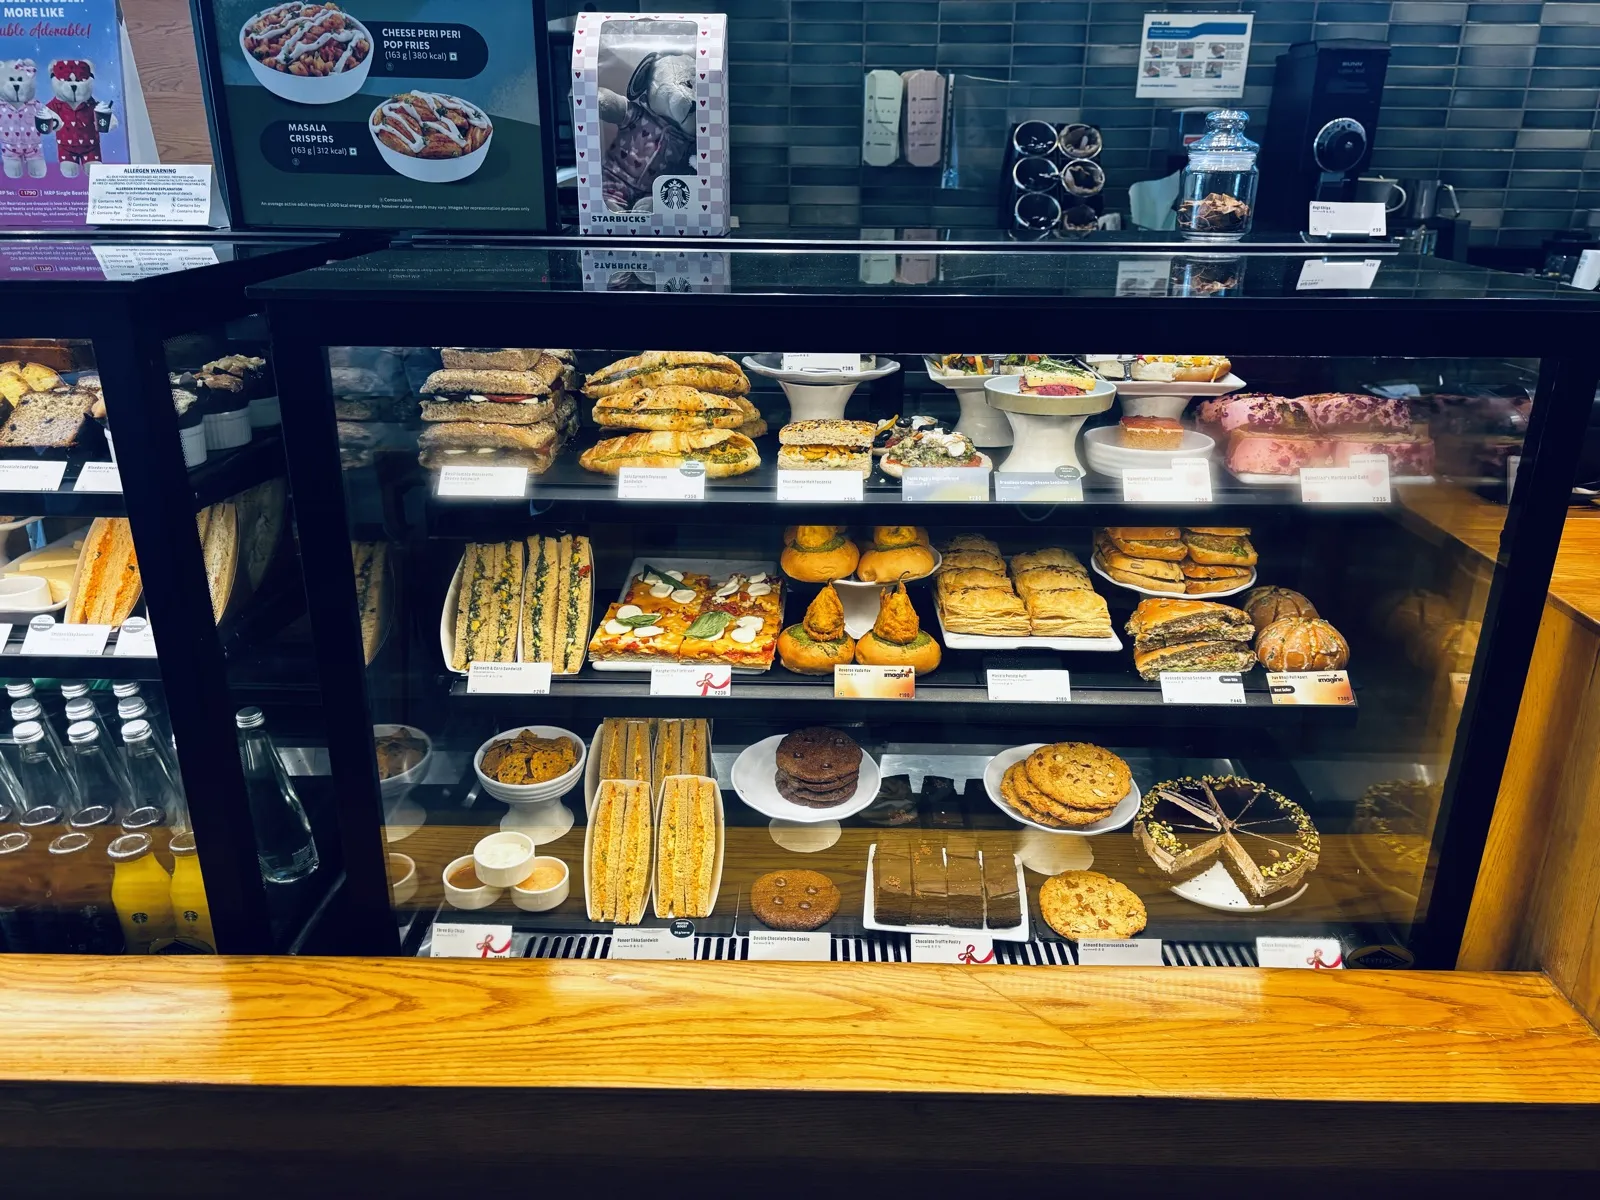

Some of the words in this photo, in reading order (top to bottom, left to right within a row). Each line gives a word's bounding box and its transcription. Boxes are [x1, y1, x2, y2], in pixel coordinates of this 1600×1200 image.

[4, 8, 38, 18] MORE
[40, 8, 64, 18] LIKE
[29, 21, 92, 39] Adorable!
[382, 28, 416, 38] CHEESE
[418, 30, 438, 38] PERI
[440, 30, 461, 38] PERI
[384, 40, 403, 49] POP
[405, 41, 430, 50] FRIES
[385, 51, 401, 60] (163
[430, 52, 447, 62] kcal)
[288, 124, 327, 132] MASALA
[290, 134, 334, 143] CRISPERS
[291, 146, 306, 155] (163
[331, 148, 348, 156] kcal)
[884, 669, 910, 679] imagine
[1318, 674, 1343, 683] imagine
